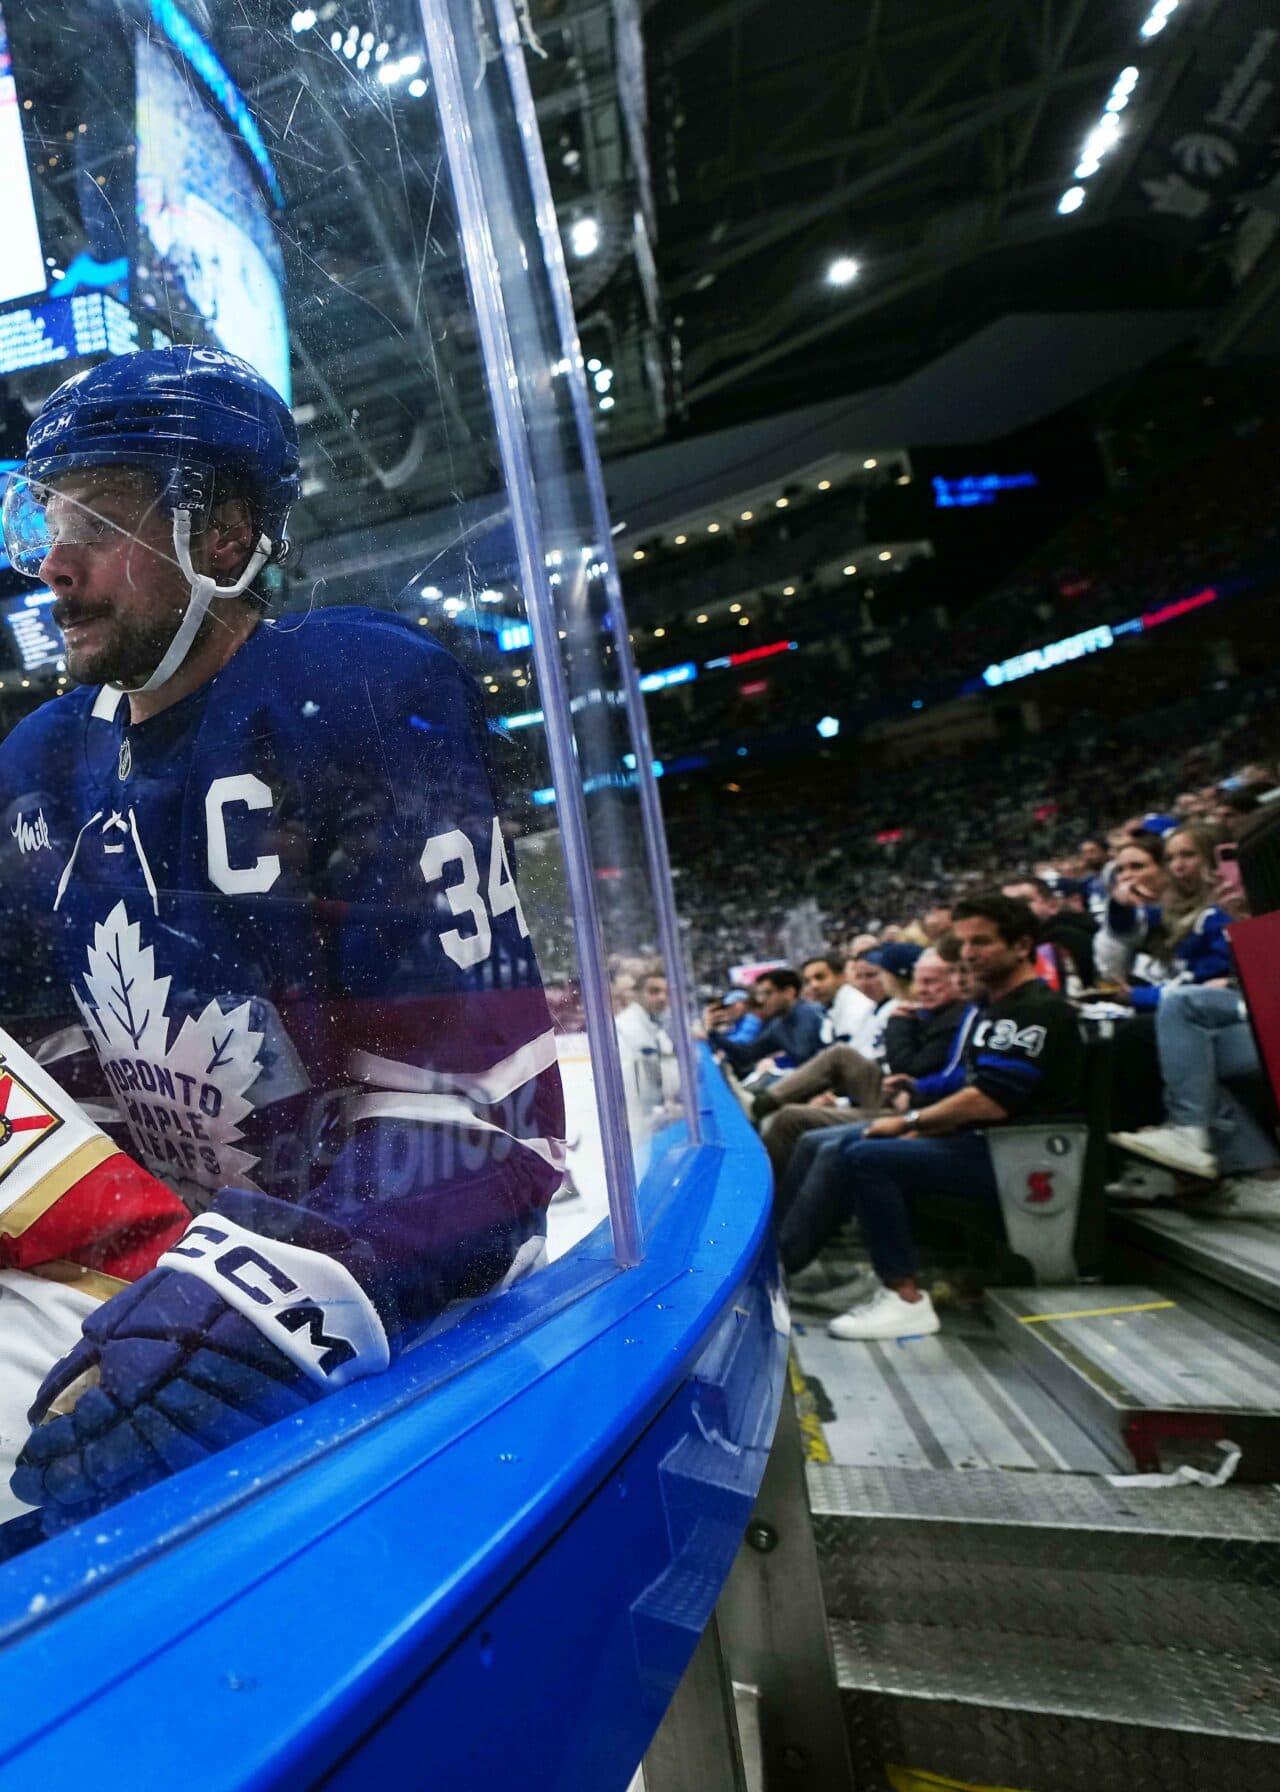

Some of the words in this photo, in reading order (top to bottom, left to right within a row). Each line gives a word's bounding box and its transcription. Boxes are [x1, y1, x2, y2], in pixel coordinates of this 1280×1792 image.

[178, 502, 205, 512] CCM
[10, 808, 52, 855] Milk
[205, 773, 281, 895] C
[419, 815, 530, 970] 34
[988, 1018, 1047, 1058] 34
[103, 1057, 223, 1118] TORONTO
[123, 1094, 210, 1141] MAPLE
[135, 1126, 221, 1175] LEAFS
[167, 1225, 360, 1378] CCM
